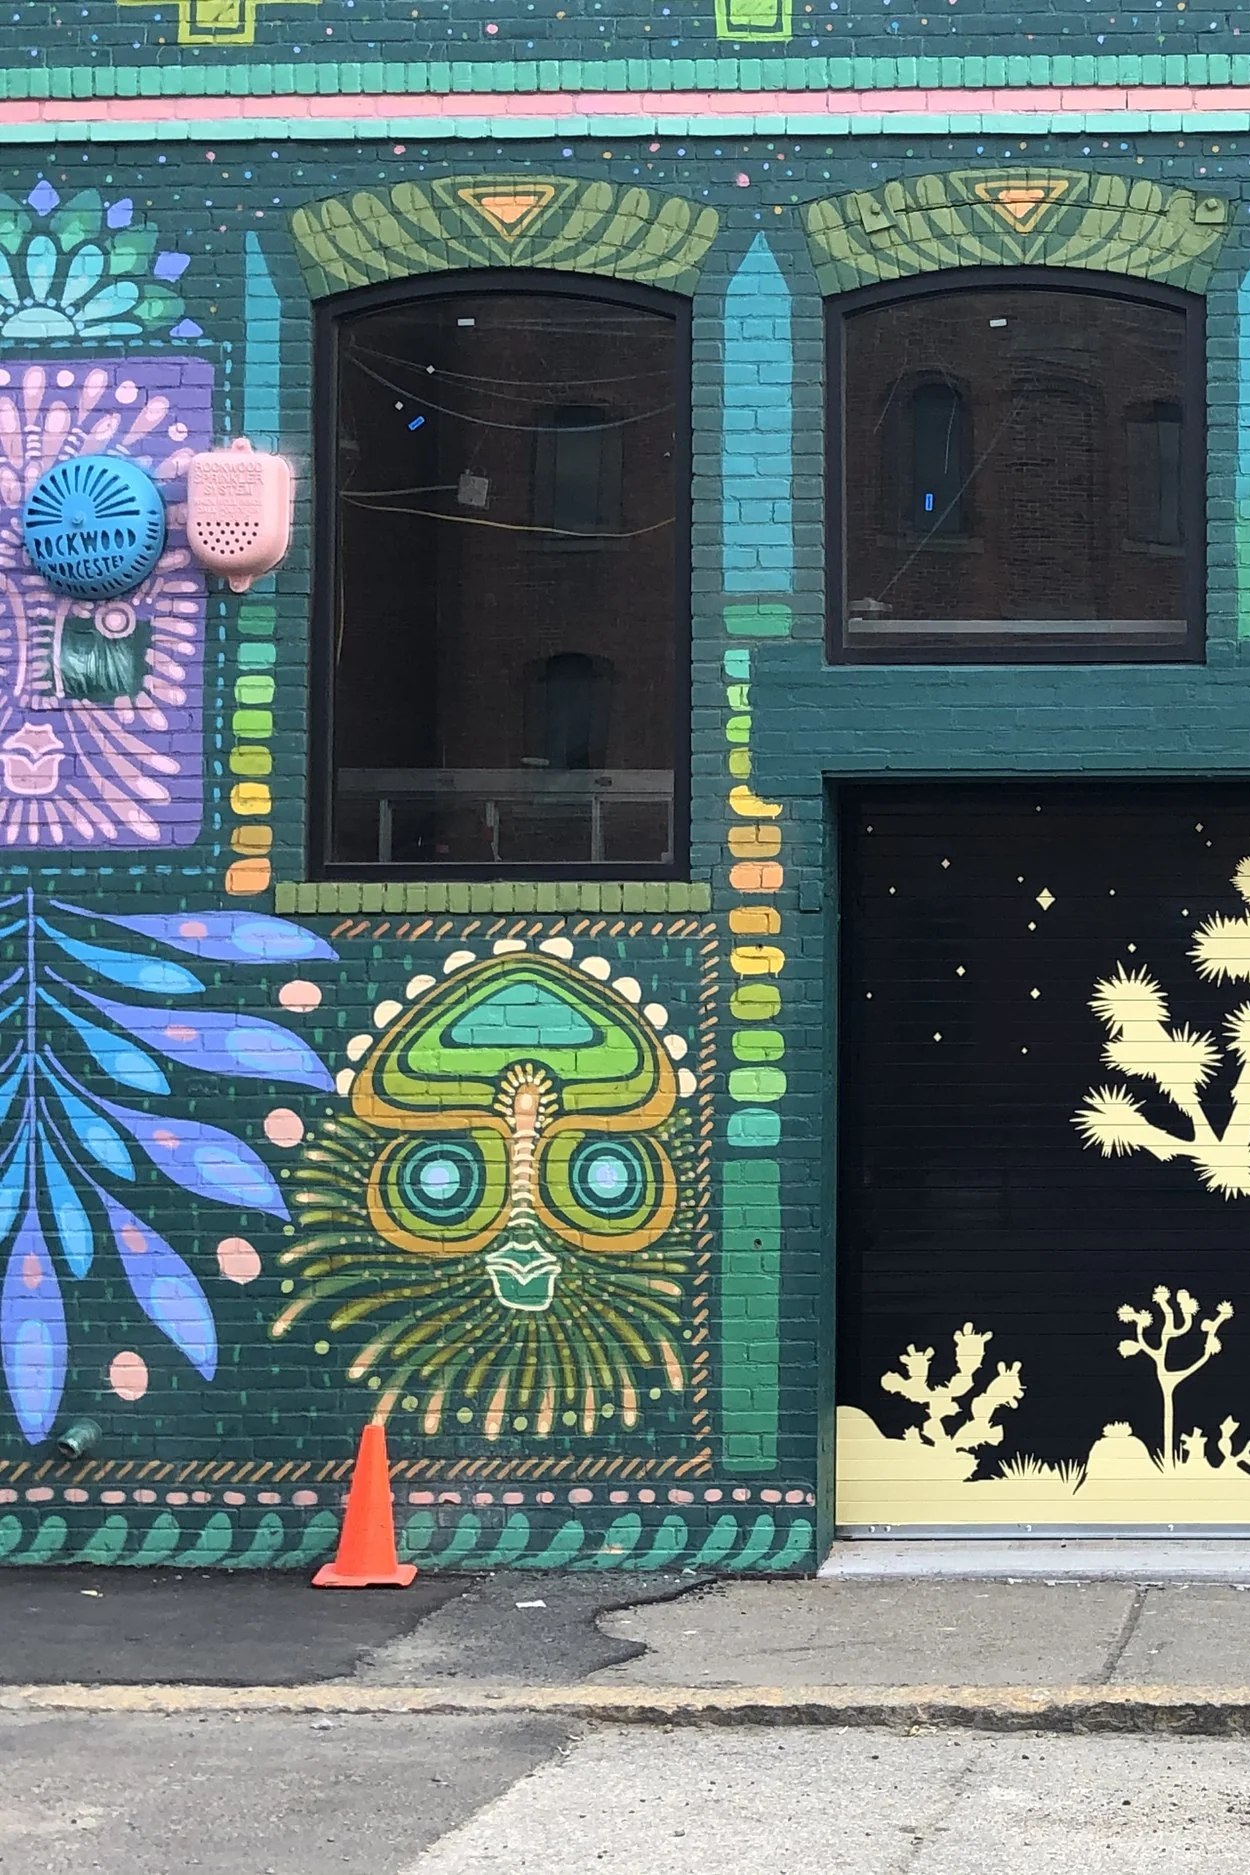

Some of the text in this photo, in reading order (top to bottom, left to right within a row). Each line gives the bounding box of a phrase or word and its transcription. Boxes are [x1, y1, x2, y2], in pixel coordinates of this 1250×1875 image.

[194, 462, 263, 473] ROCKWOOD
[193, 473, 265, 485] SPRINKLER
[203, 485, 253, 496] SYSTEM
[33, 527, 137, 560] ROCKWOOD
[47, 554, 125, 581] WORCESTER
